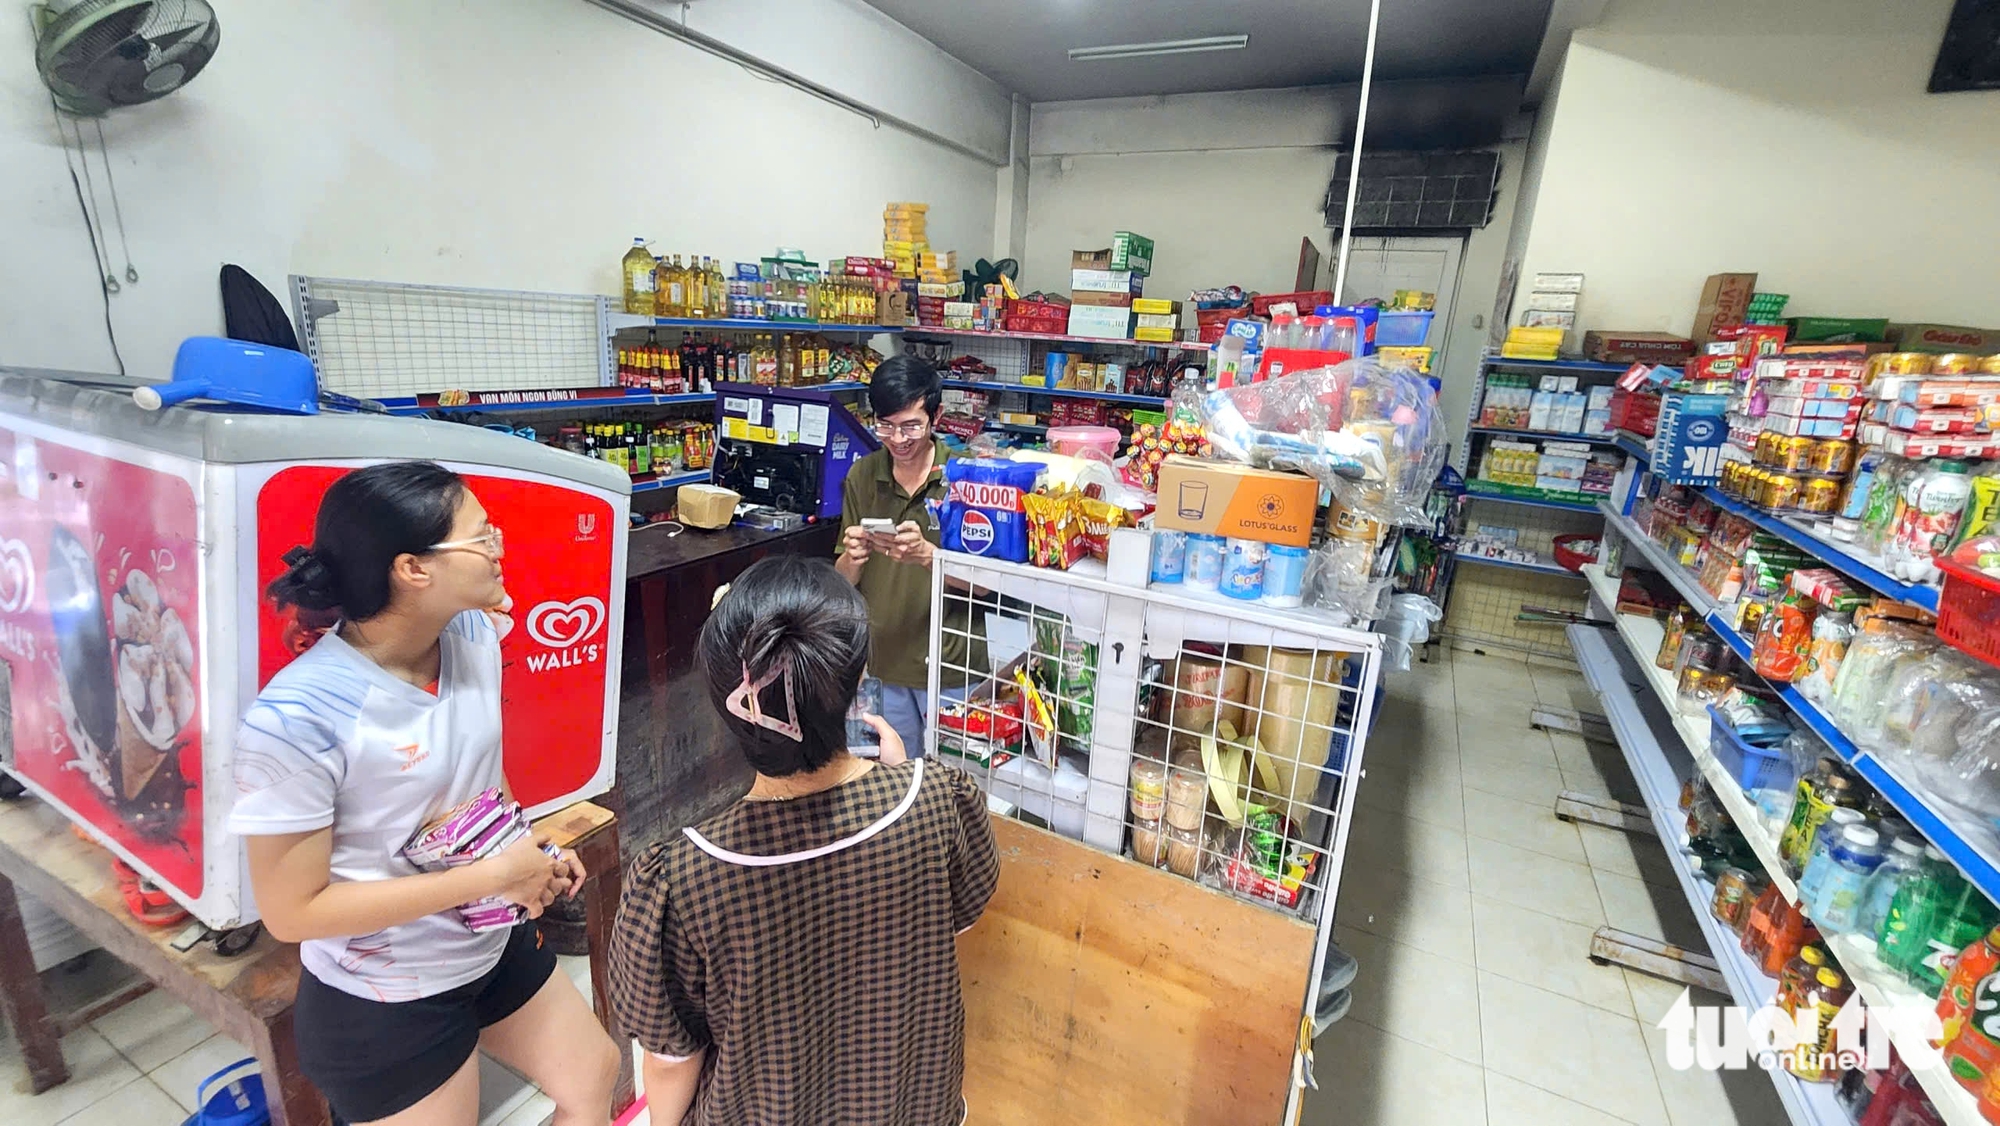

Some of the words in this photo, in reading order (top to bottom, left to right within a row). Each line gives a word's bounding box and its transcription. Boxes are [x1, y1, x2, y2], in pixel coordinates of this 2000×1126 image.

[1683, 446, 1728, 477] ilk
[962, 524, 991, 538] PEPSI
[1239, 518, 1268, 531] LOTUS
[1269, 523, 1299, 534] GLASS
[526, 644, 599, 674] WALL'S
